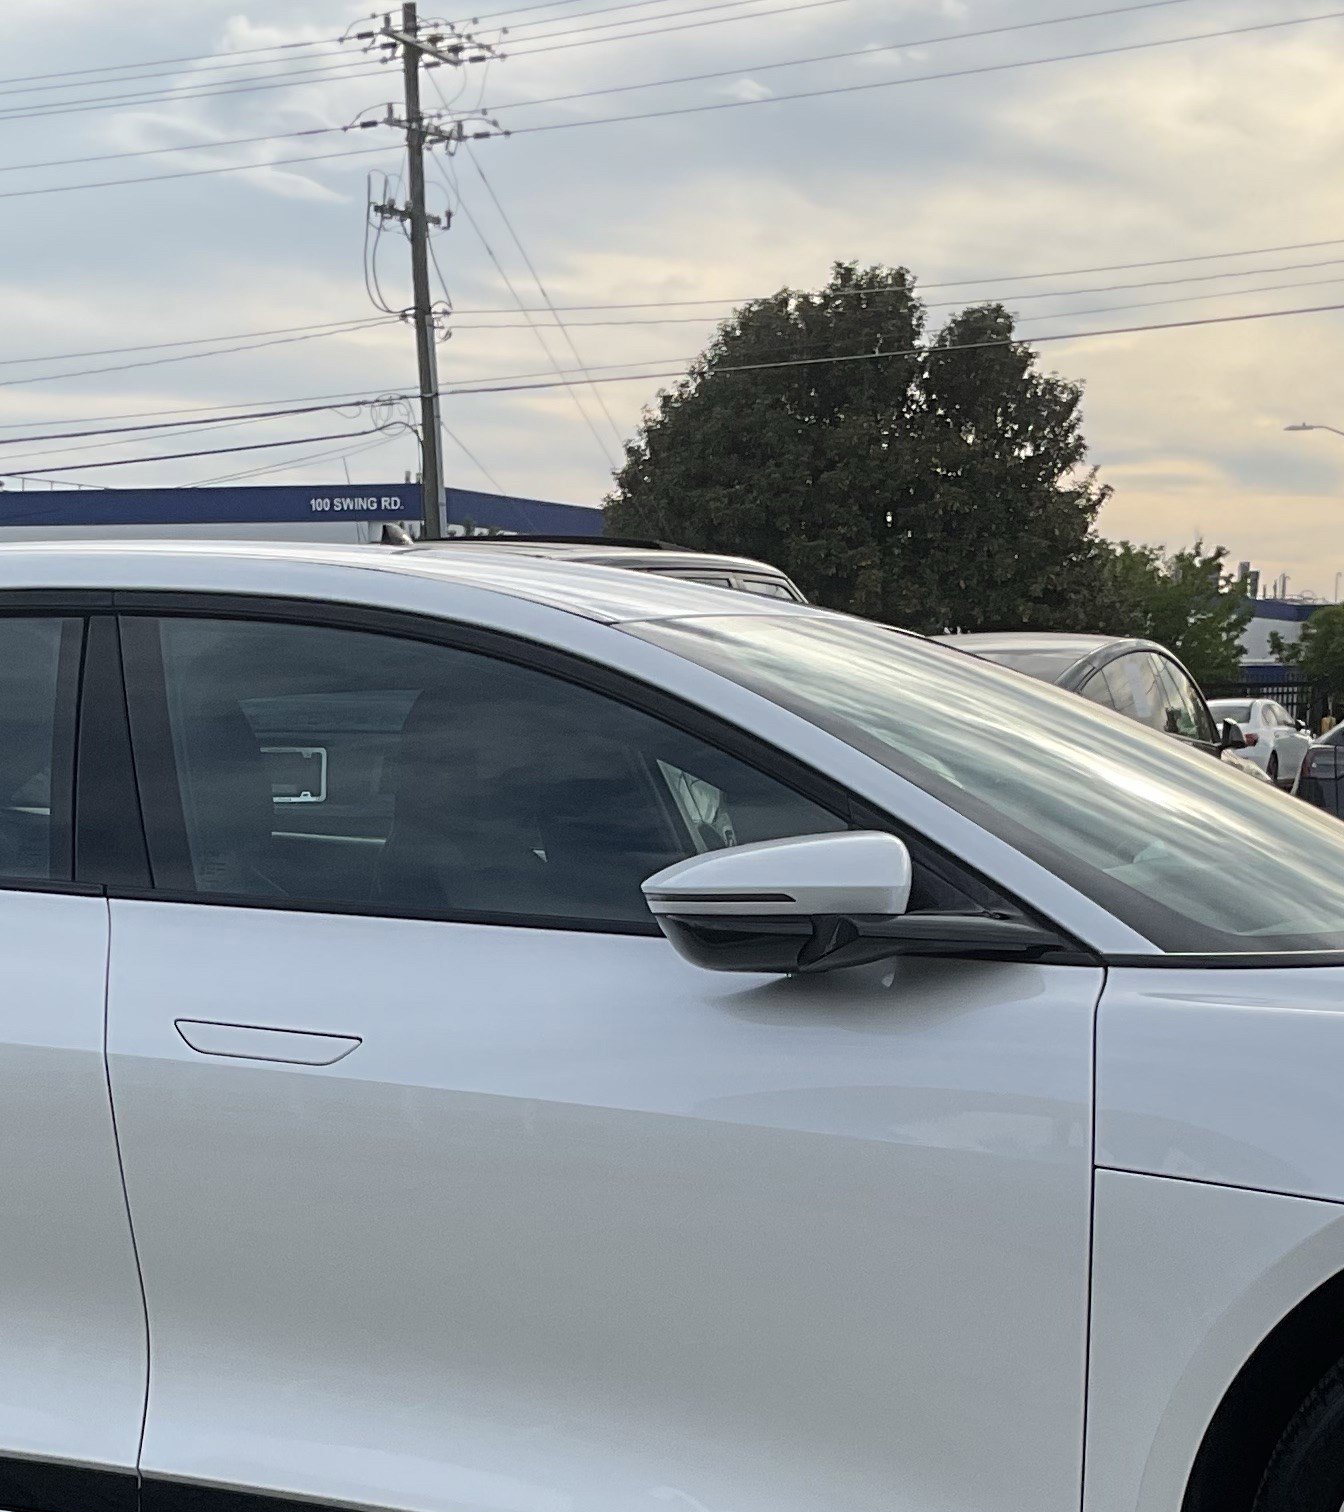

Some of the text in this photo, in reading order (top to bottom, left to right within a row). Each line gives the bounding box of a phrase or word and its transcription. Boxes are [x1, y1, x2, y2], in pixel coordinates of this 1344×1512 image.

[310, 496, 405, 511] 100 SWING RD.
